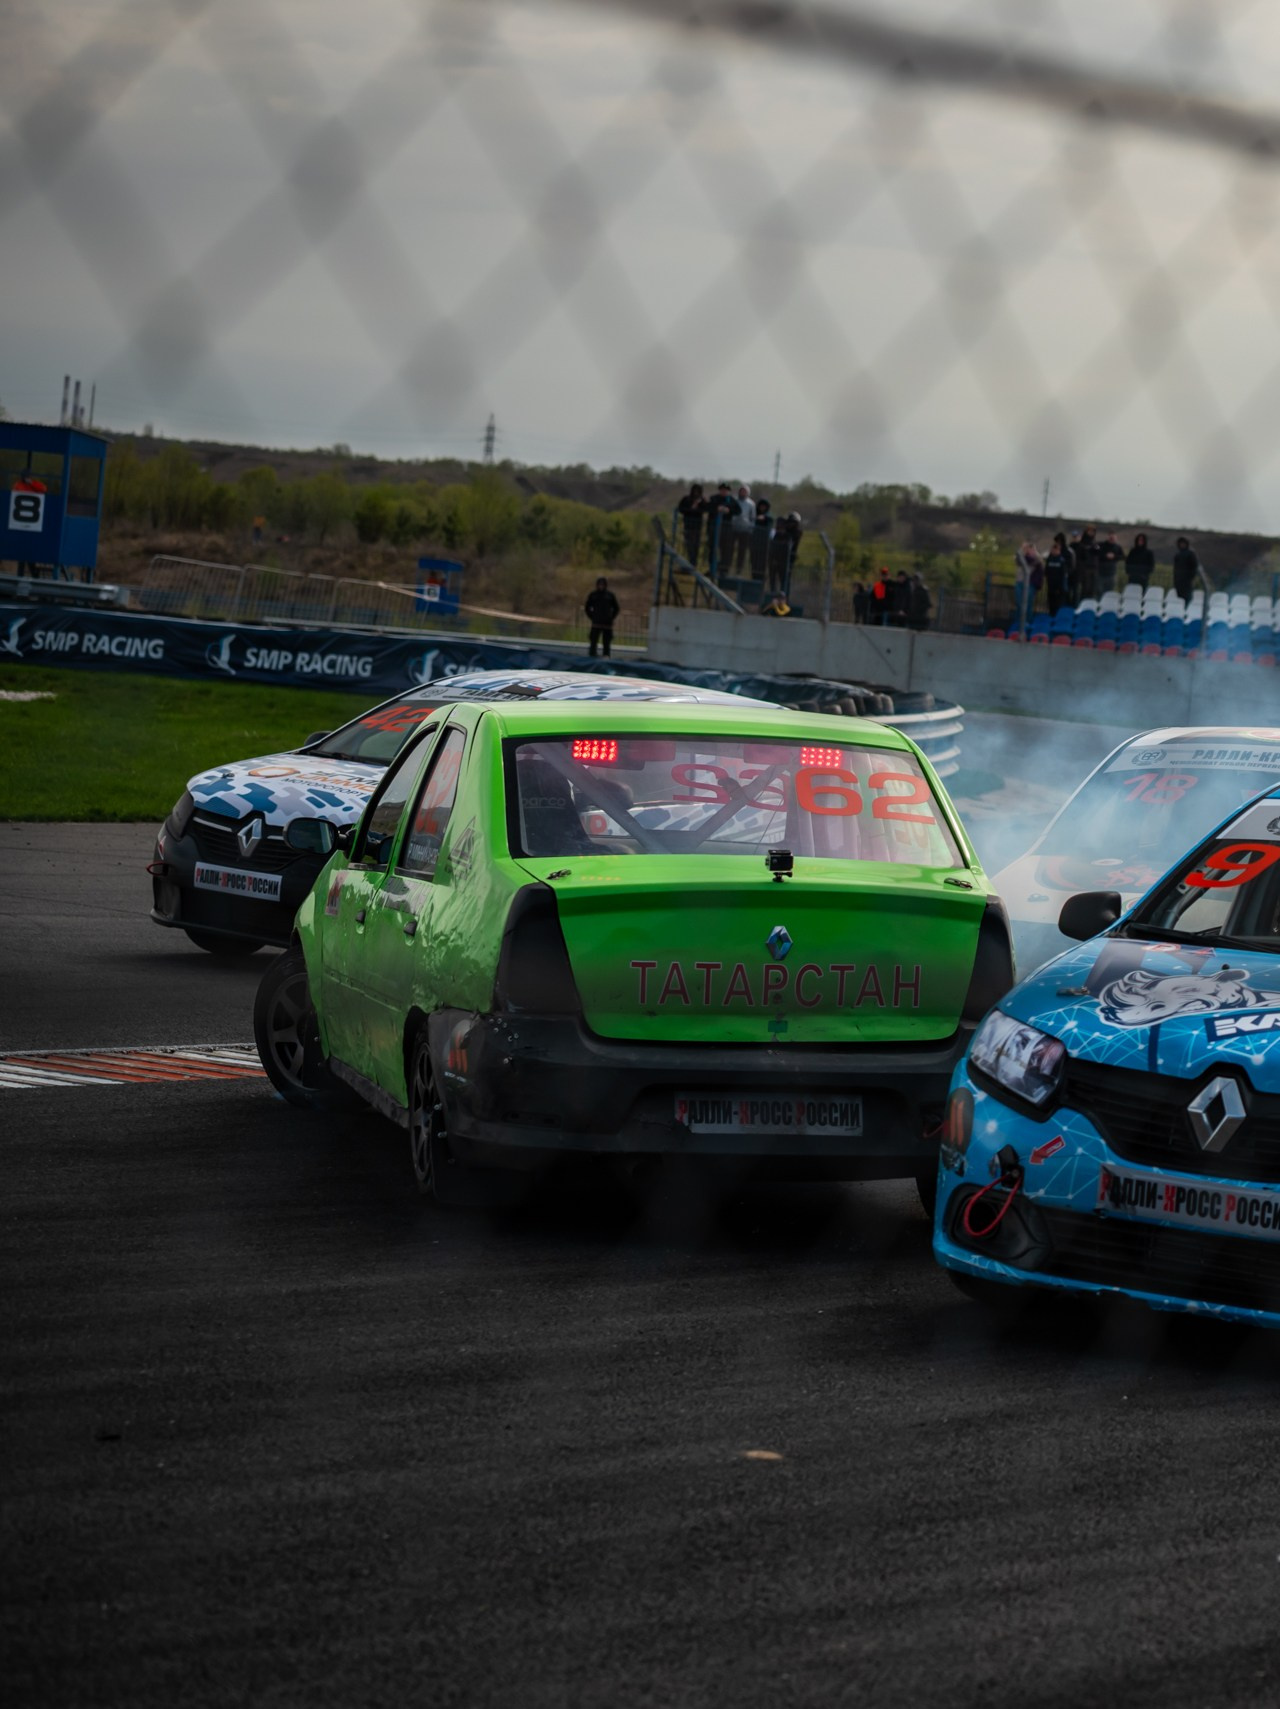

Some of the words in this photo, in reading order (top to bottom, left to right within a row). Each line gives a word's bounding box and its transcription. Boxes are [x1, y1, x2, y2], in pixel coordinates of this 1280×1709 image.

[13, 494, 41, 524] 8
[32, 630, 79, 652] SMP
[81, 633, 166, 660] RACING
[244, 647, 293, 672] SMP
[295, 651, 374, 678] RACING
[360, 706, 436, 732] 42
[282, 777, 365, 797] МОТОРСПОРТ
[795, 768, 935, 825] 62
[1124, 773, 1198, 804] 18
[195, 867, 247, 891] РАЛЛИ-КРОСС
[247, 875, 280, 896] РОССИИ
[630, 960, 921, 1009] ТАТАРСТАН
[676, 1099, 793, 1126] РАЛЛИ-КРОСС
[795, 1100, 861, 1128] РОССИИ
[1100, 1172, 1223, 1220] РАЛЛИ-КРОСС
